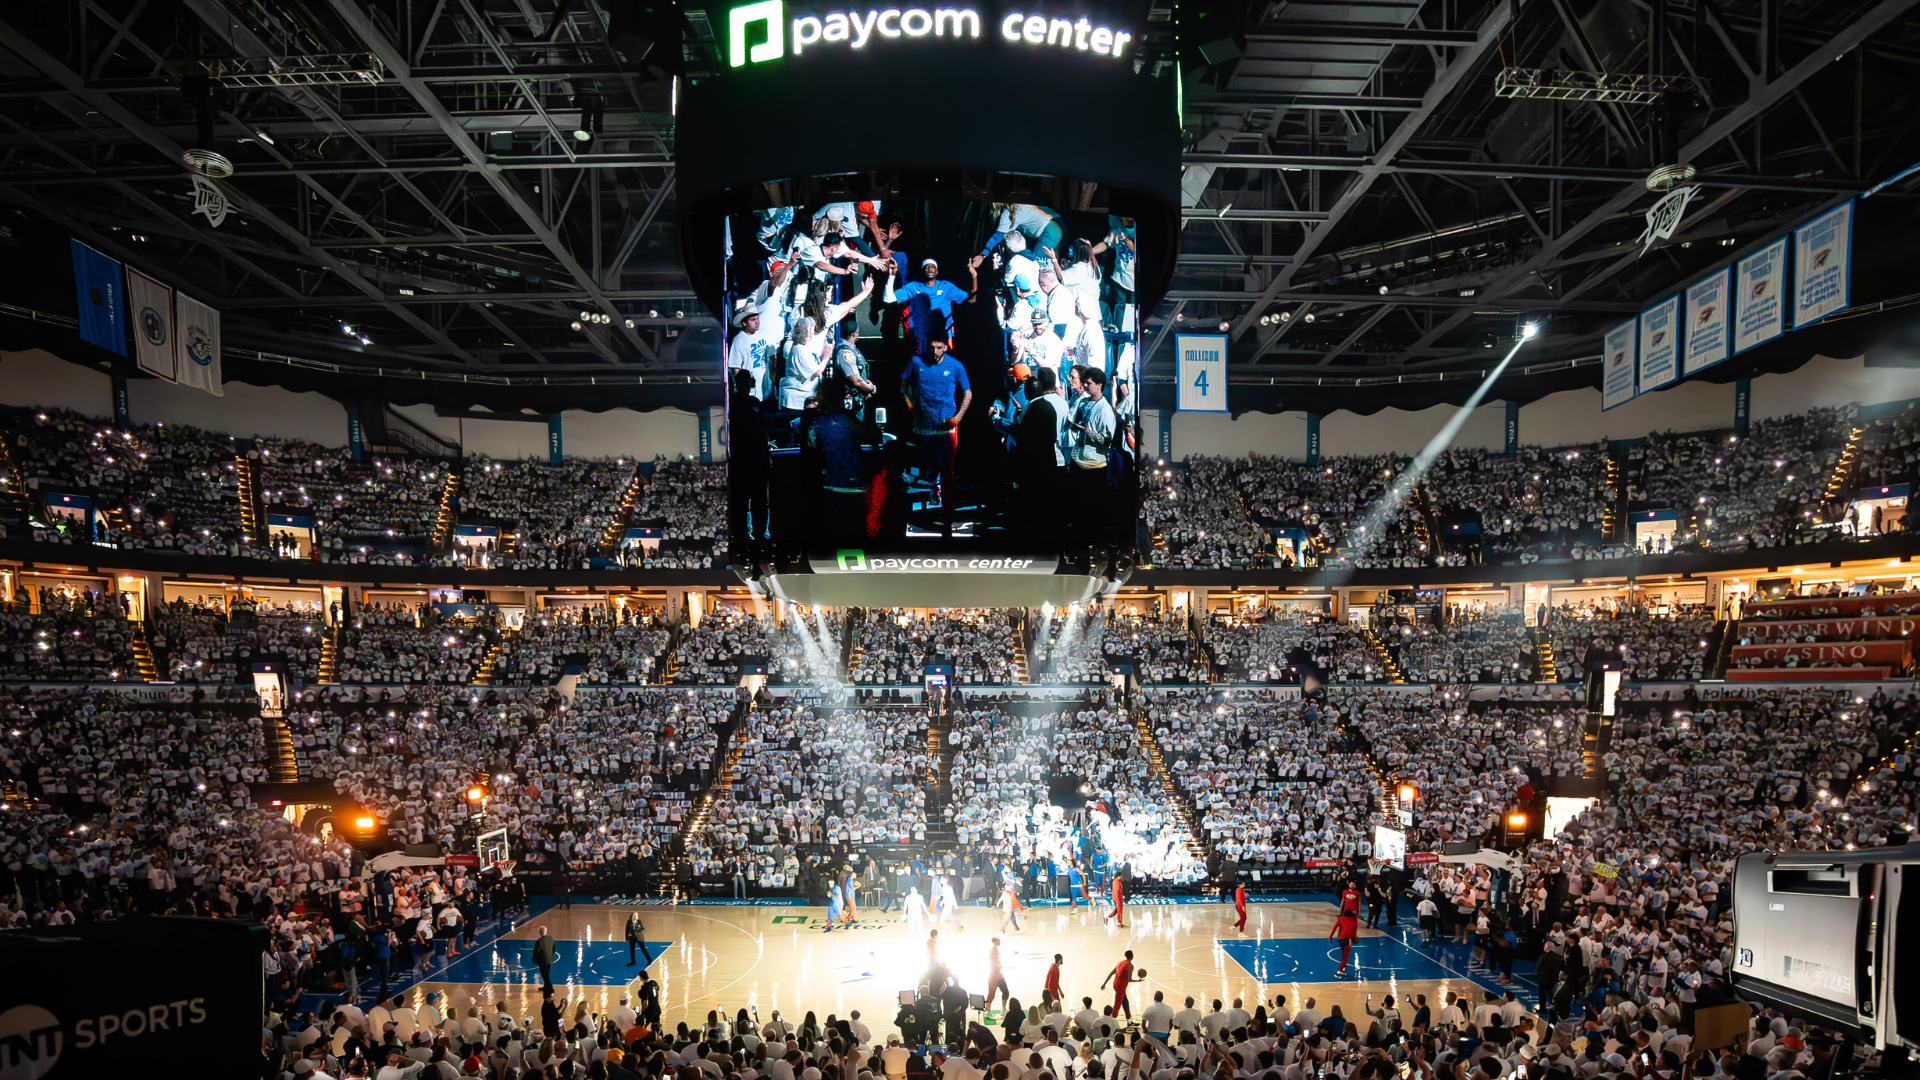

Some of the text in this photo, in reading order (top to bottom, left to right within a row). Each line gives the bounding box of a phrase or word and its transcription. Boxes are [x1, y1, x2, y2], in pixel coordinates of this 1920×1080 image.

[792, 7, 1131, 58] paycom center
[1194, 370, 1209, 396] 4
[869, 557, 1033, 571] paycom center
[74, 997, 207, 1049] SPORTS
